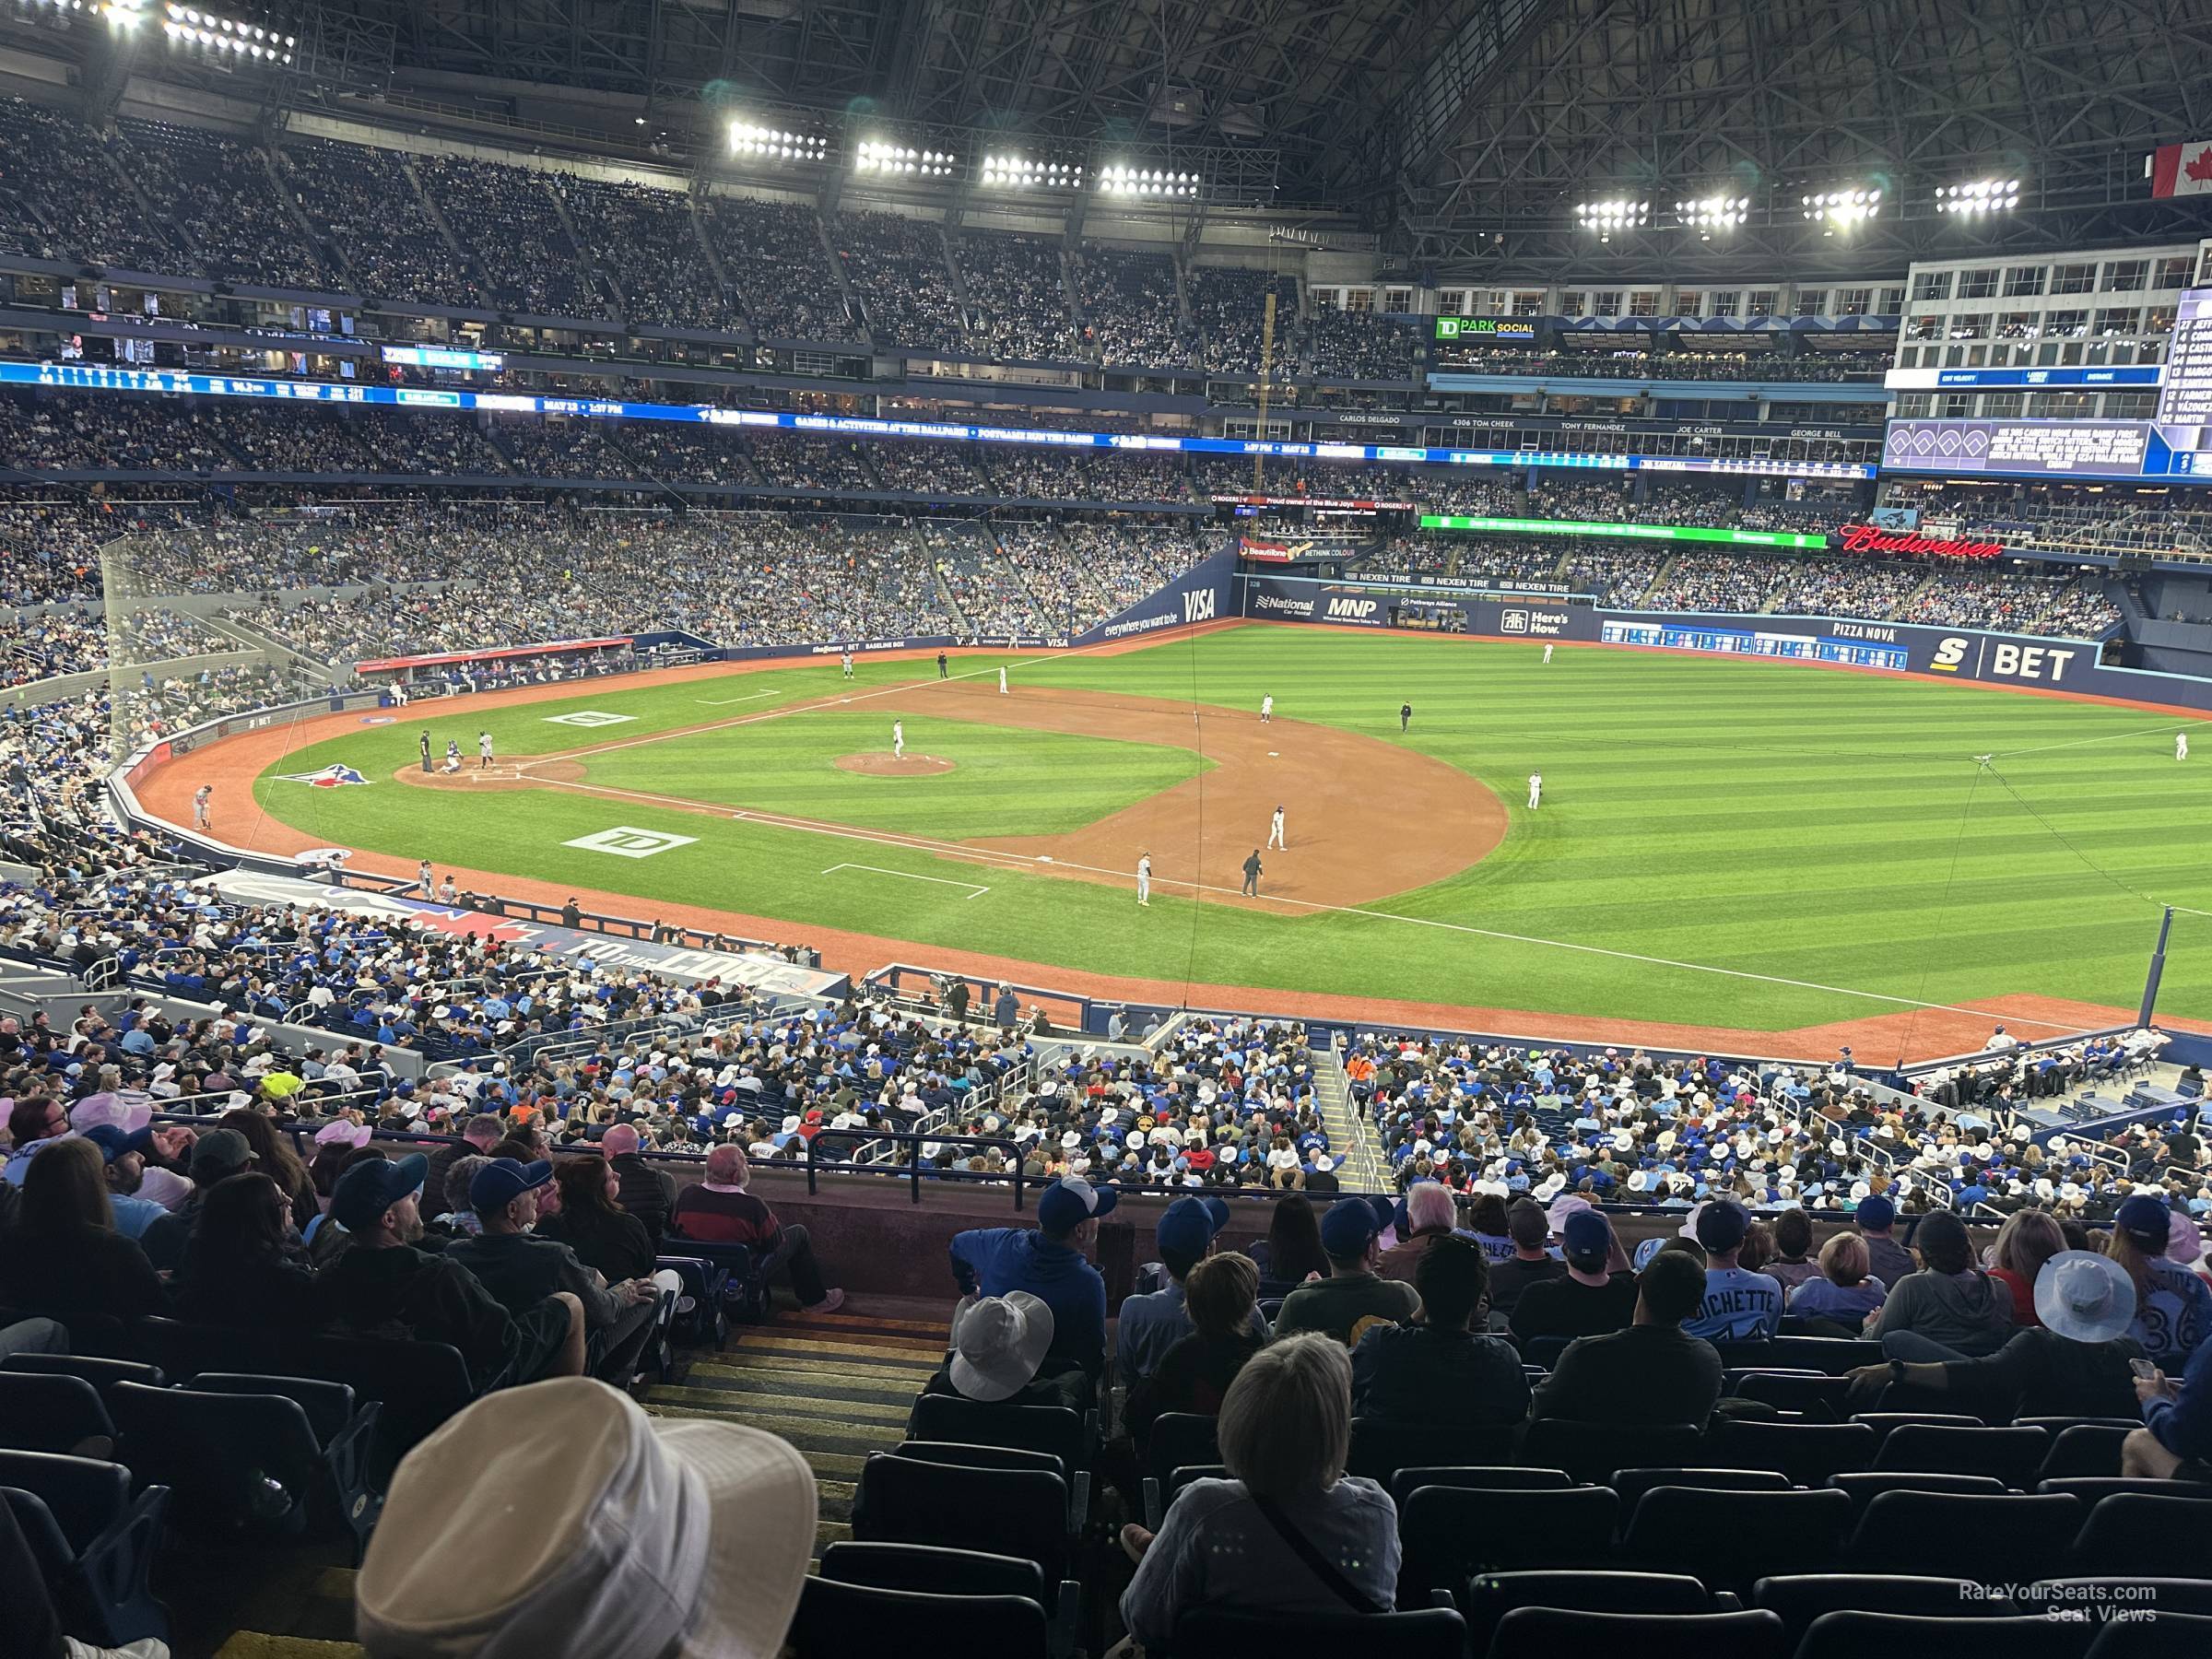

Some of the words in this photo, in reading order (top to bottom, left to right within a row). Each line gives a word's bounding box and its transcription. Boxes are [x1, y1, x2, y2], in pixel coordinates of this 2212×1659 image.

[1439, 322, 1458, 335] TD
[1460, 320, 1497, 332] PARK
[1497, 324, 1535, 333] SOCIAL
[2180, 321, 2192, 330] 27
[2180, 332, 2186, 341] 4
[2175, 344, 2186, 353] 50
[544, 400, 566, 410] MAY
[1368, 416, 1400, 424] DELGADO
[2174, 414, 2206, 423] MARTIN
[837, 419, 888, 431] ACTIVITIES
[1583, 423, 1626, 431] FERNANDEZ
[1840, 525, 2006, 558] Budweiser
[1359, 573, 1389, 582] NEXEN
[1436, 578, 1467, 587] NEXEN
[1469, 579, 1489, 588] TIRE
[1515, 582, 1547, 591] NEXEN
[1548, 583, 1570, 593] TIRE
[1268, 597, 1314, 611] National
[1327, 598, 1376, 617] MNP
[1105, 619, 1138, 637] everywhere
[1139, 618, 1150, 632] you
[1150, 617, 1163, 629] want
[1170, 612, 1177, 623] be
[1182, 588, 1215, 623] VISA
[1531, 612, 1569, 624] Here's
[1530, 623, 1560, 634] How.
[1832, 623, 1863, 638] PIZZA
[1865, 627, 1895, 642] NOVA
[955, 637, 978, 646] VA
[1046, 638, 1069, 647] VISA
[1993, 643, 2076, 680] BET
[258, 716, 271, 726] BET
[596, 830, 672, 850] TD
[563, 937, 630, 961] TO
[1700, 1289, 1775, 1318] ICHETTE
[2139, 1303, 2199, 1355] 36
